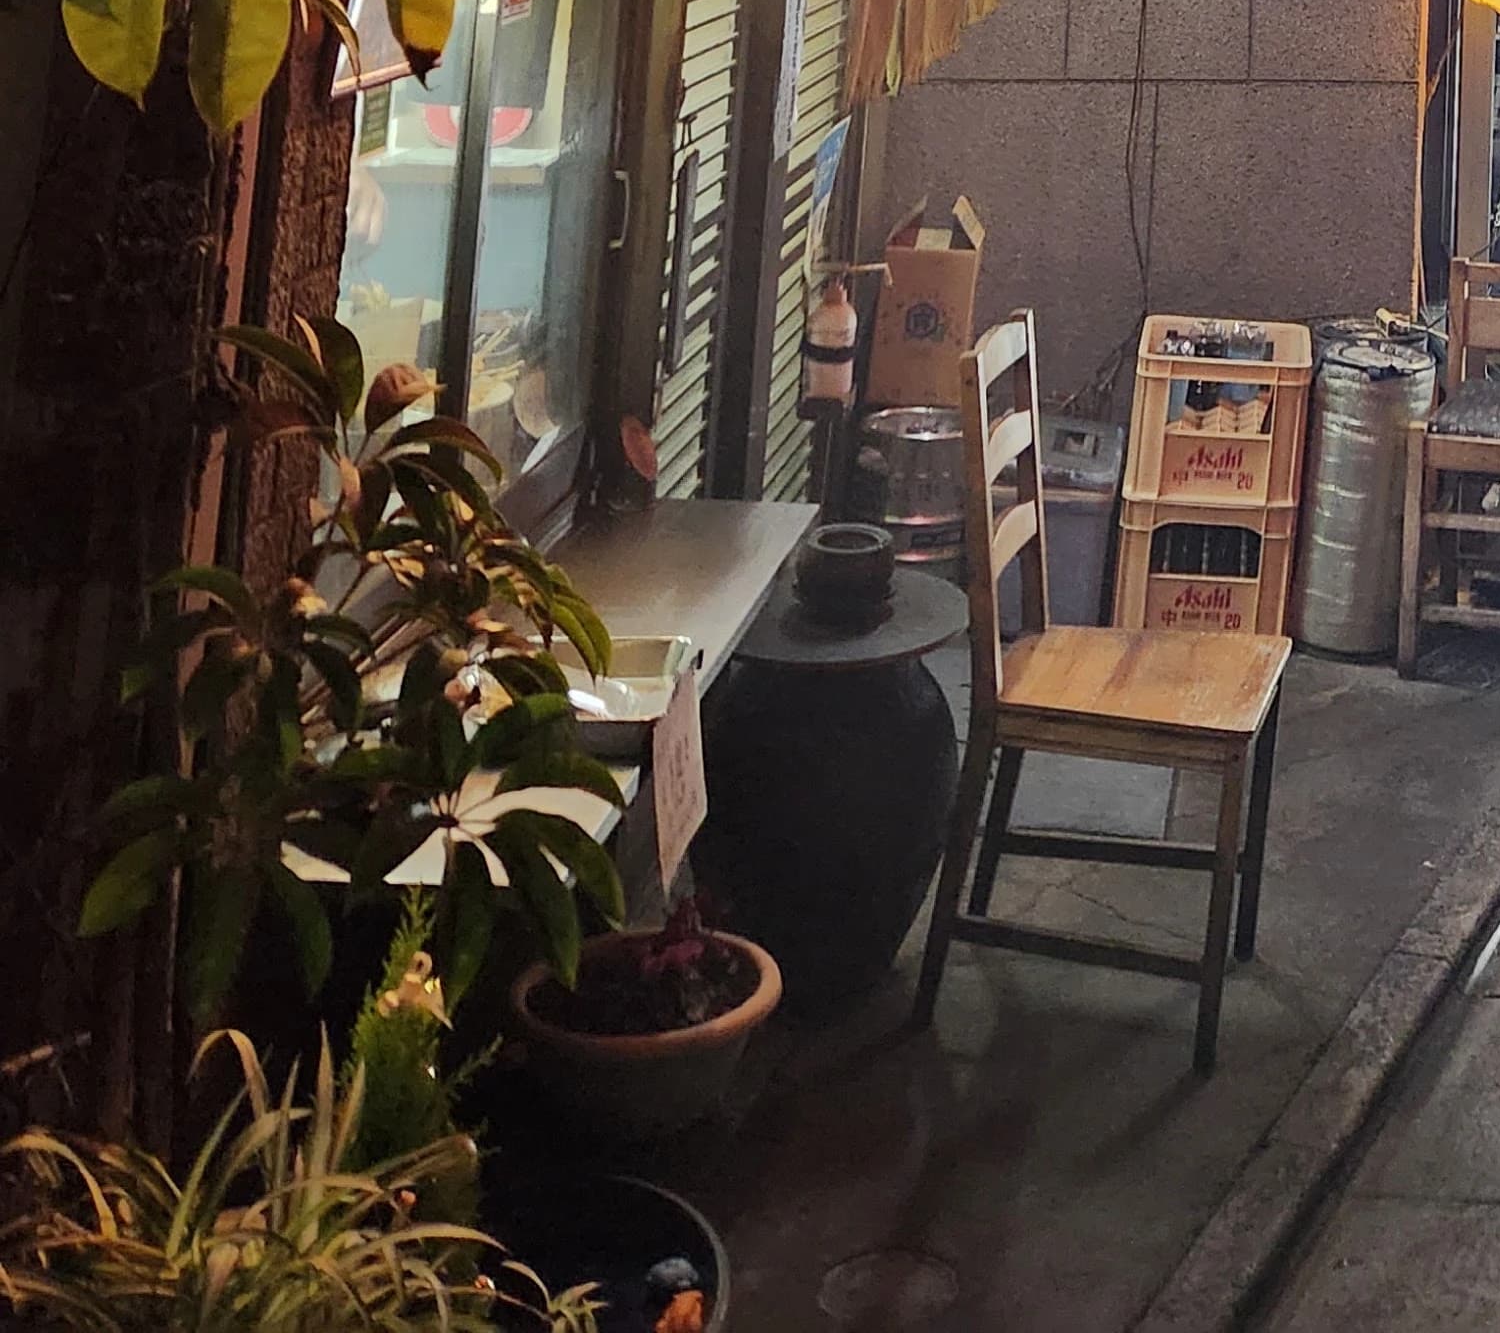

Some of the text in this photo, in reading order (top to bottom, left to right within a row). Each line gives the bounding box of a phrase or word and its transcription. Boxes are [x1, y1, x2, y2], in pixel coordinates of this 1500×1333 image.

[1187, 444, 1245, 469] Asahi
[1174, 586, 1233, 610] Asahi
[1223, 612, 1242, 630] 20
